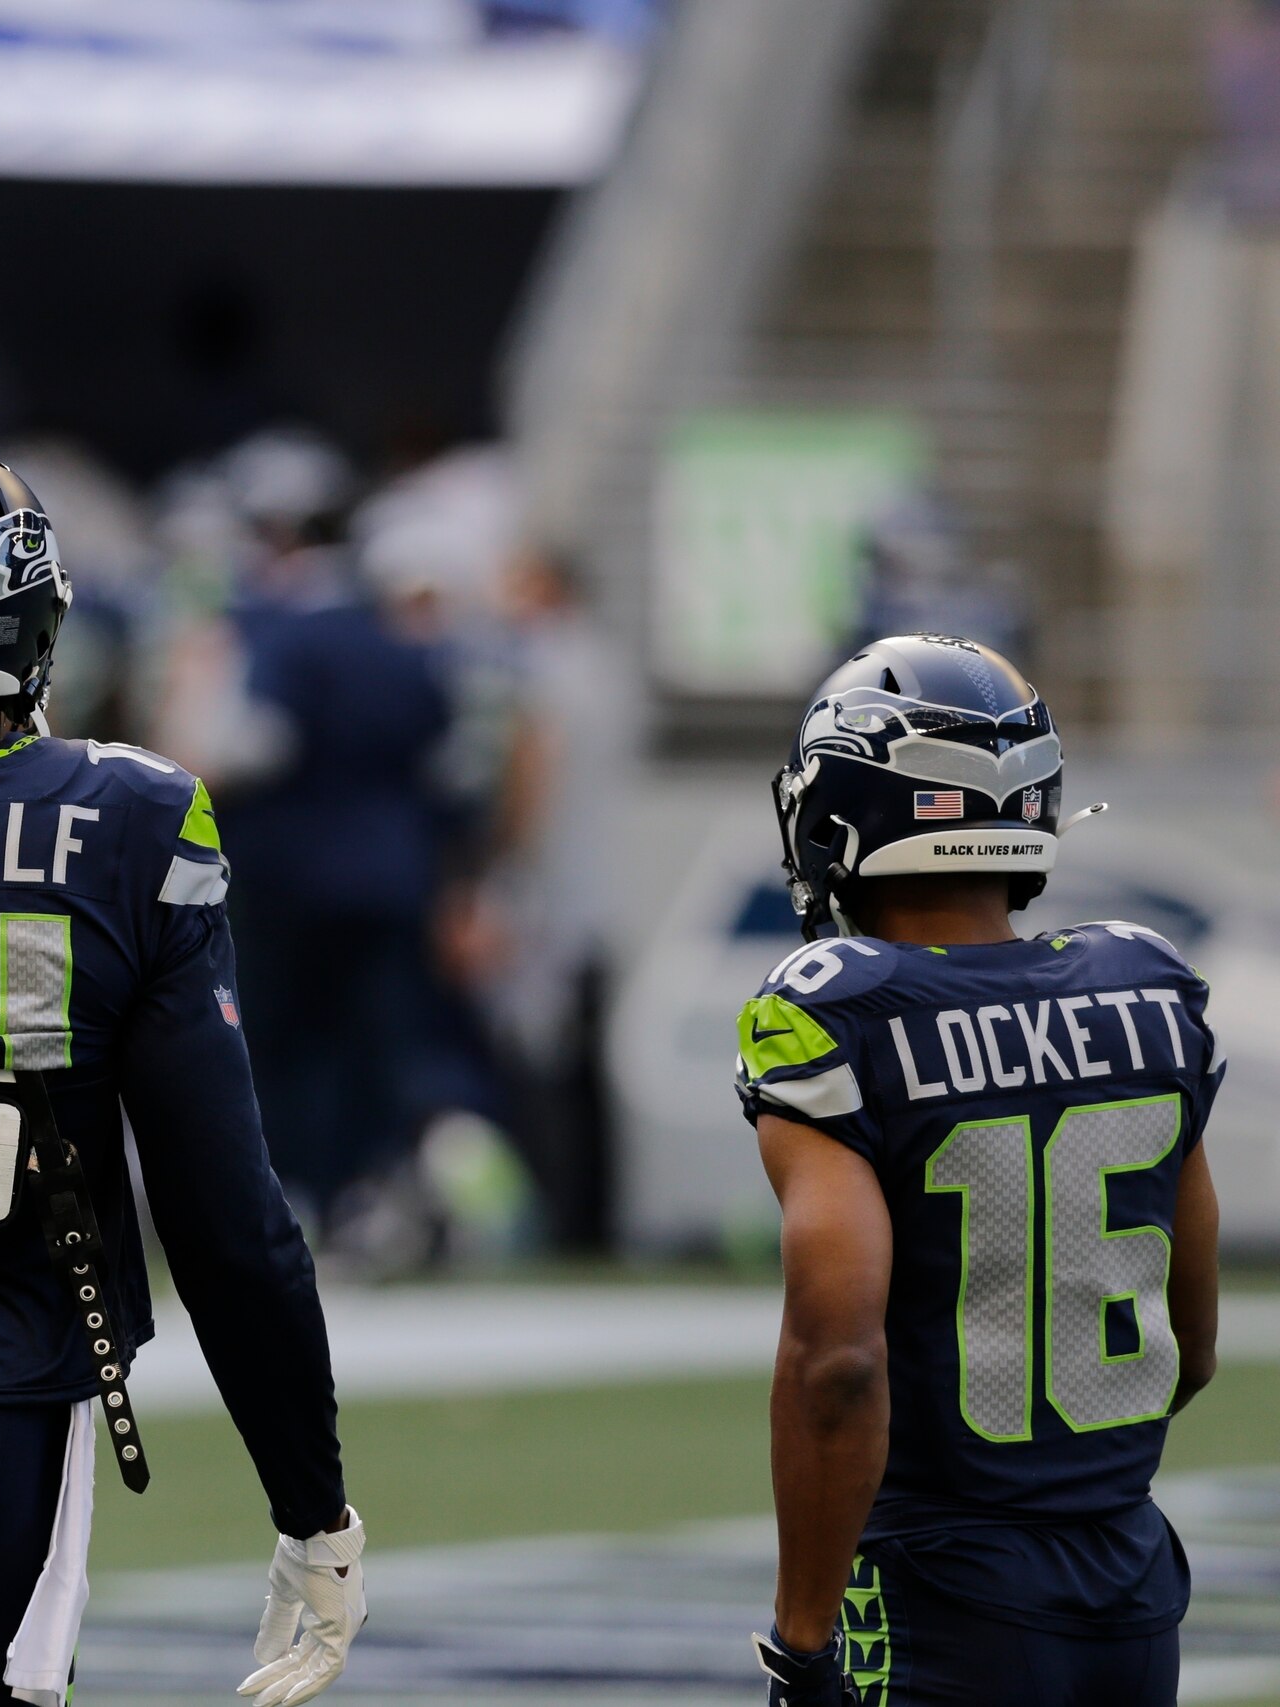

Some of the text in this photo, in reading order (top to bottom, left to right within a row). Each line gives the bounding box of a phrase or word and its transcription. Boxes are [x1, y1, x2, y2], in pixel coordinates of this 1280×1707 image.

[1024, 803, 1039, 817] NFL
[933, 844, 1043, 856] BLACK LIVES MATTER
[888, 989, 1186, 1101] LOCKETT
[924, 1092, 1182, 1444] 16
